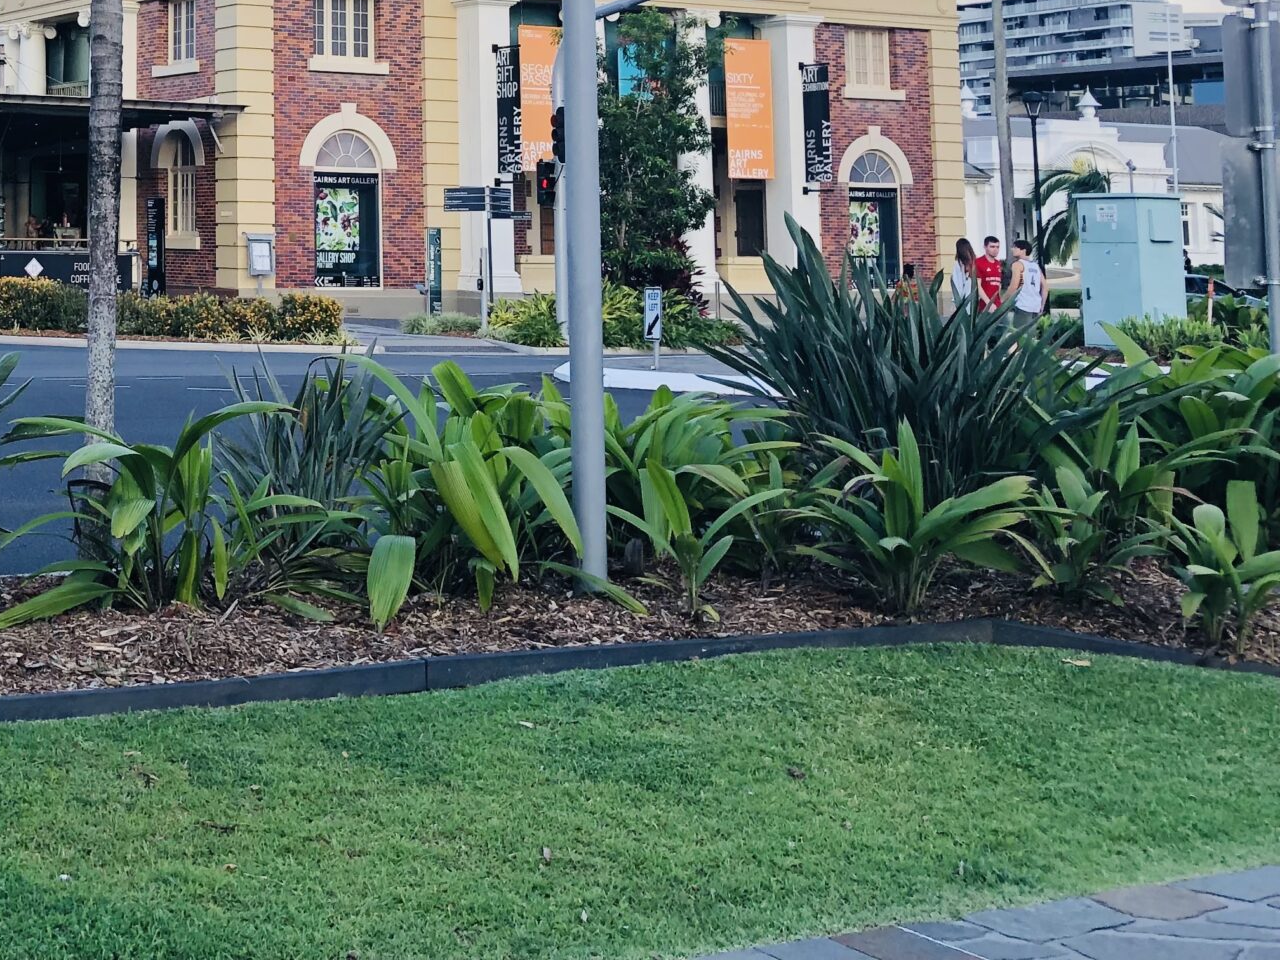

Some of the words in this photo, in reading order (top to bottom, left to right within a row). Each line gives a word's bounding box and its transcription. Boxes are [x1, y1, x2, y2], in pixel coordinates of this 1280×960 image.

[496, 49, 510, 65] ART
[496, 66, 514, 82] GIFT
[727, 72, 754, 84] SIXTY
[802, 67, 818, 82] ART
[497, 82, 518, 98] SHOP
[499, 116, 508, 174] CAIRNS
[513, 106, 523, 173] GALLERY
[523, 141, 553, 152] CAIRN
[506, 144, 516, 173] ART
[524, 151, 543, 161] ART
[728, 149, 763, 160] CAIRNS
[806, 130, 816, 182] CAIRNS
[822, 120, 832, 182] GALLERY
[729, 159, 747, 169] ART
[815, 155, 825, 182] ART
[728, 168, 769, 178] GALLERY
[340, 253, 356, 263] SHOP
[648, 292, 659, 301] KEEP
[648, 302, 658, 311] LEFT
